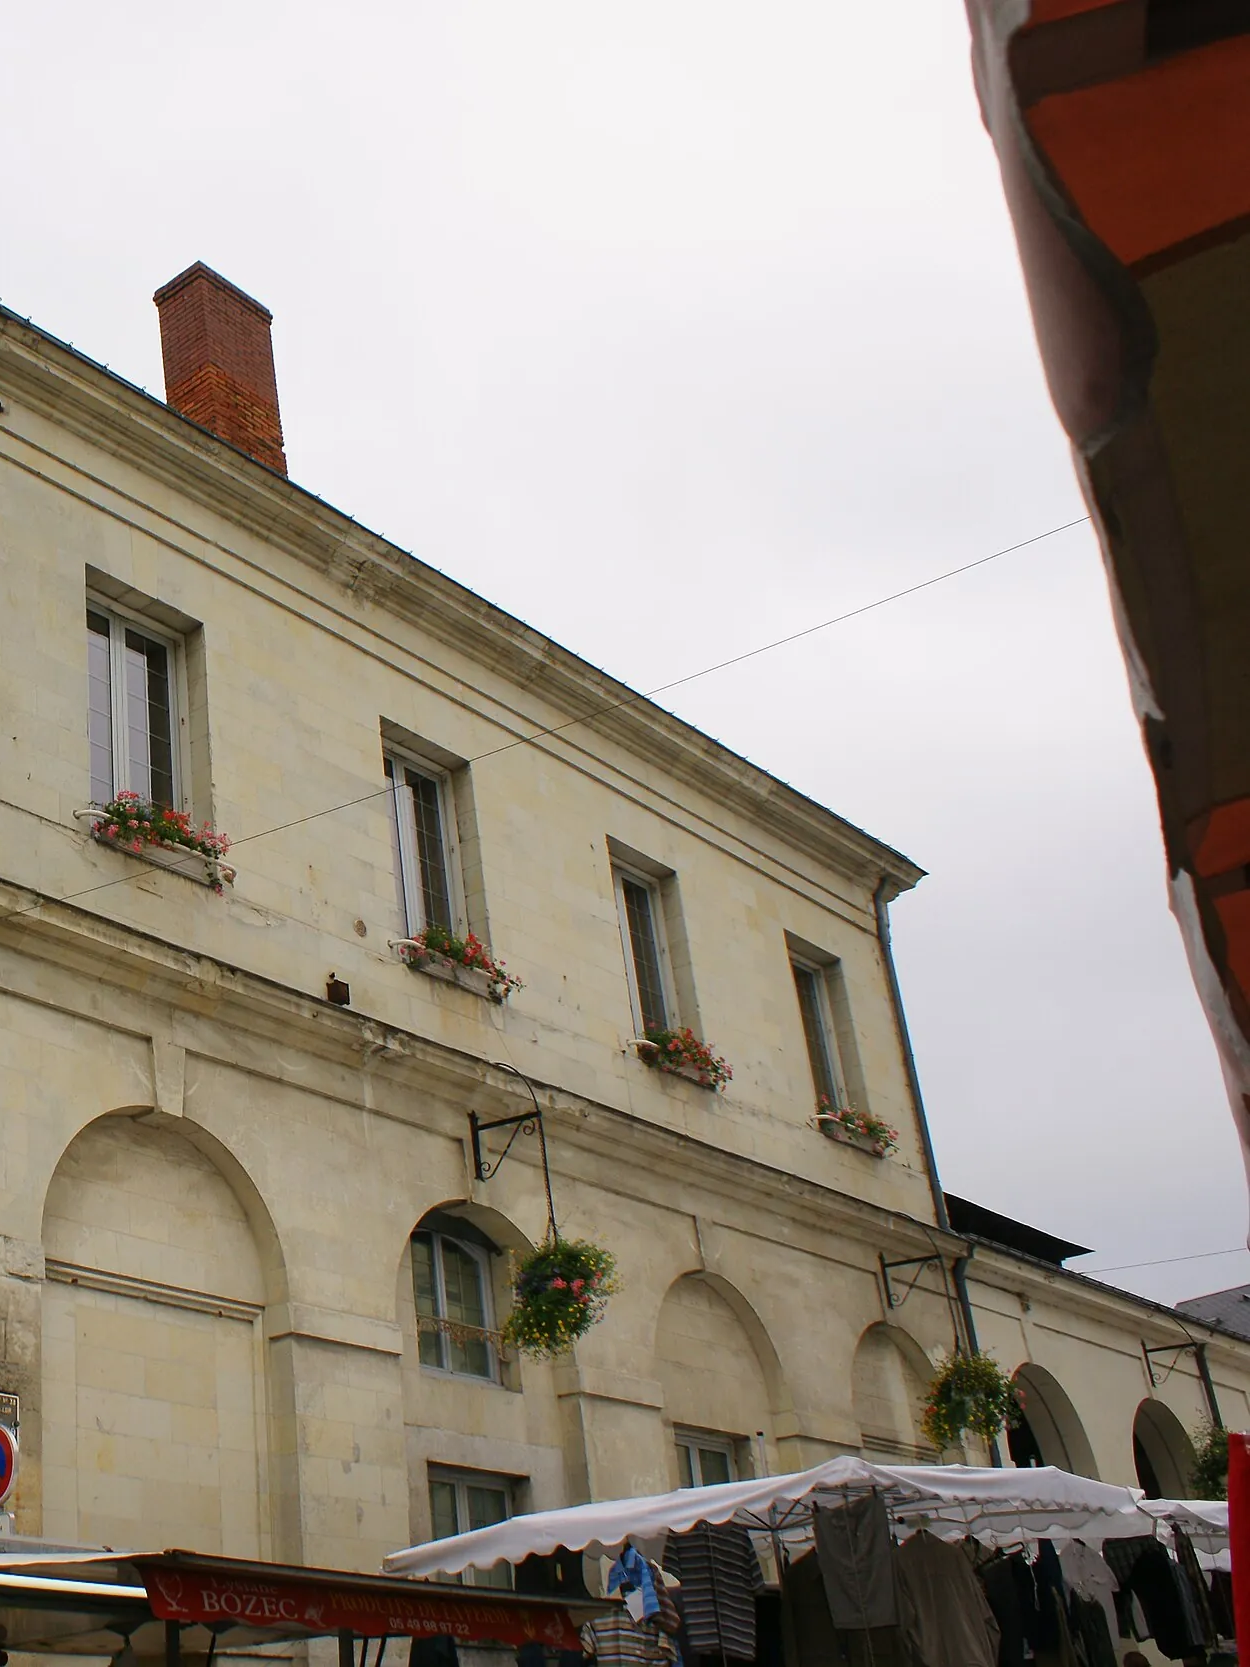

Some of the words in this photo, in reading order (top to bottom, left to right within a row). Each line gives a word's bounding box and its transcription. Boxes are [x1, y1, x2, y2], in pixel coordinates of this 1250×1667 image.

[200, 1590, 298, 1620] BOZEC
[330, 1591, 414, 1617] PRODUITS
[418, 1601, 440, 1618] DE
[389, 1617, 404, 1629] 05
[407, 1618, 420, 1631] 49
[455, 1623, 470, 1635] 22
